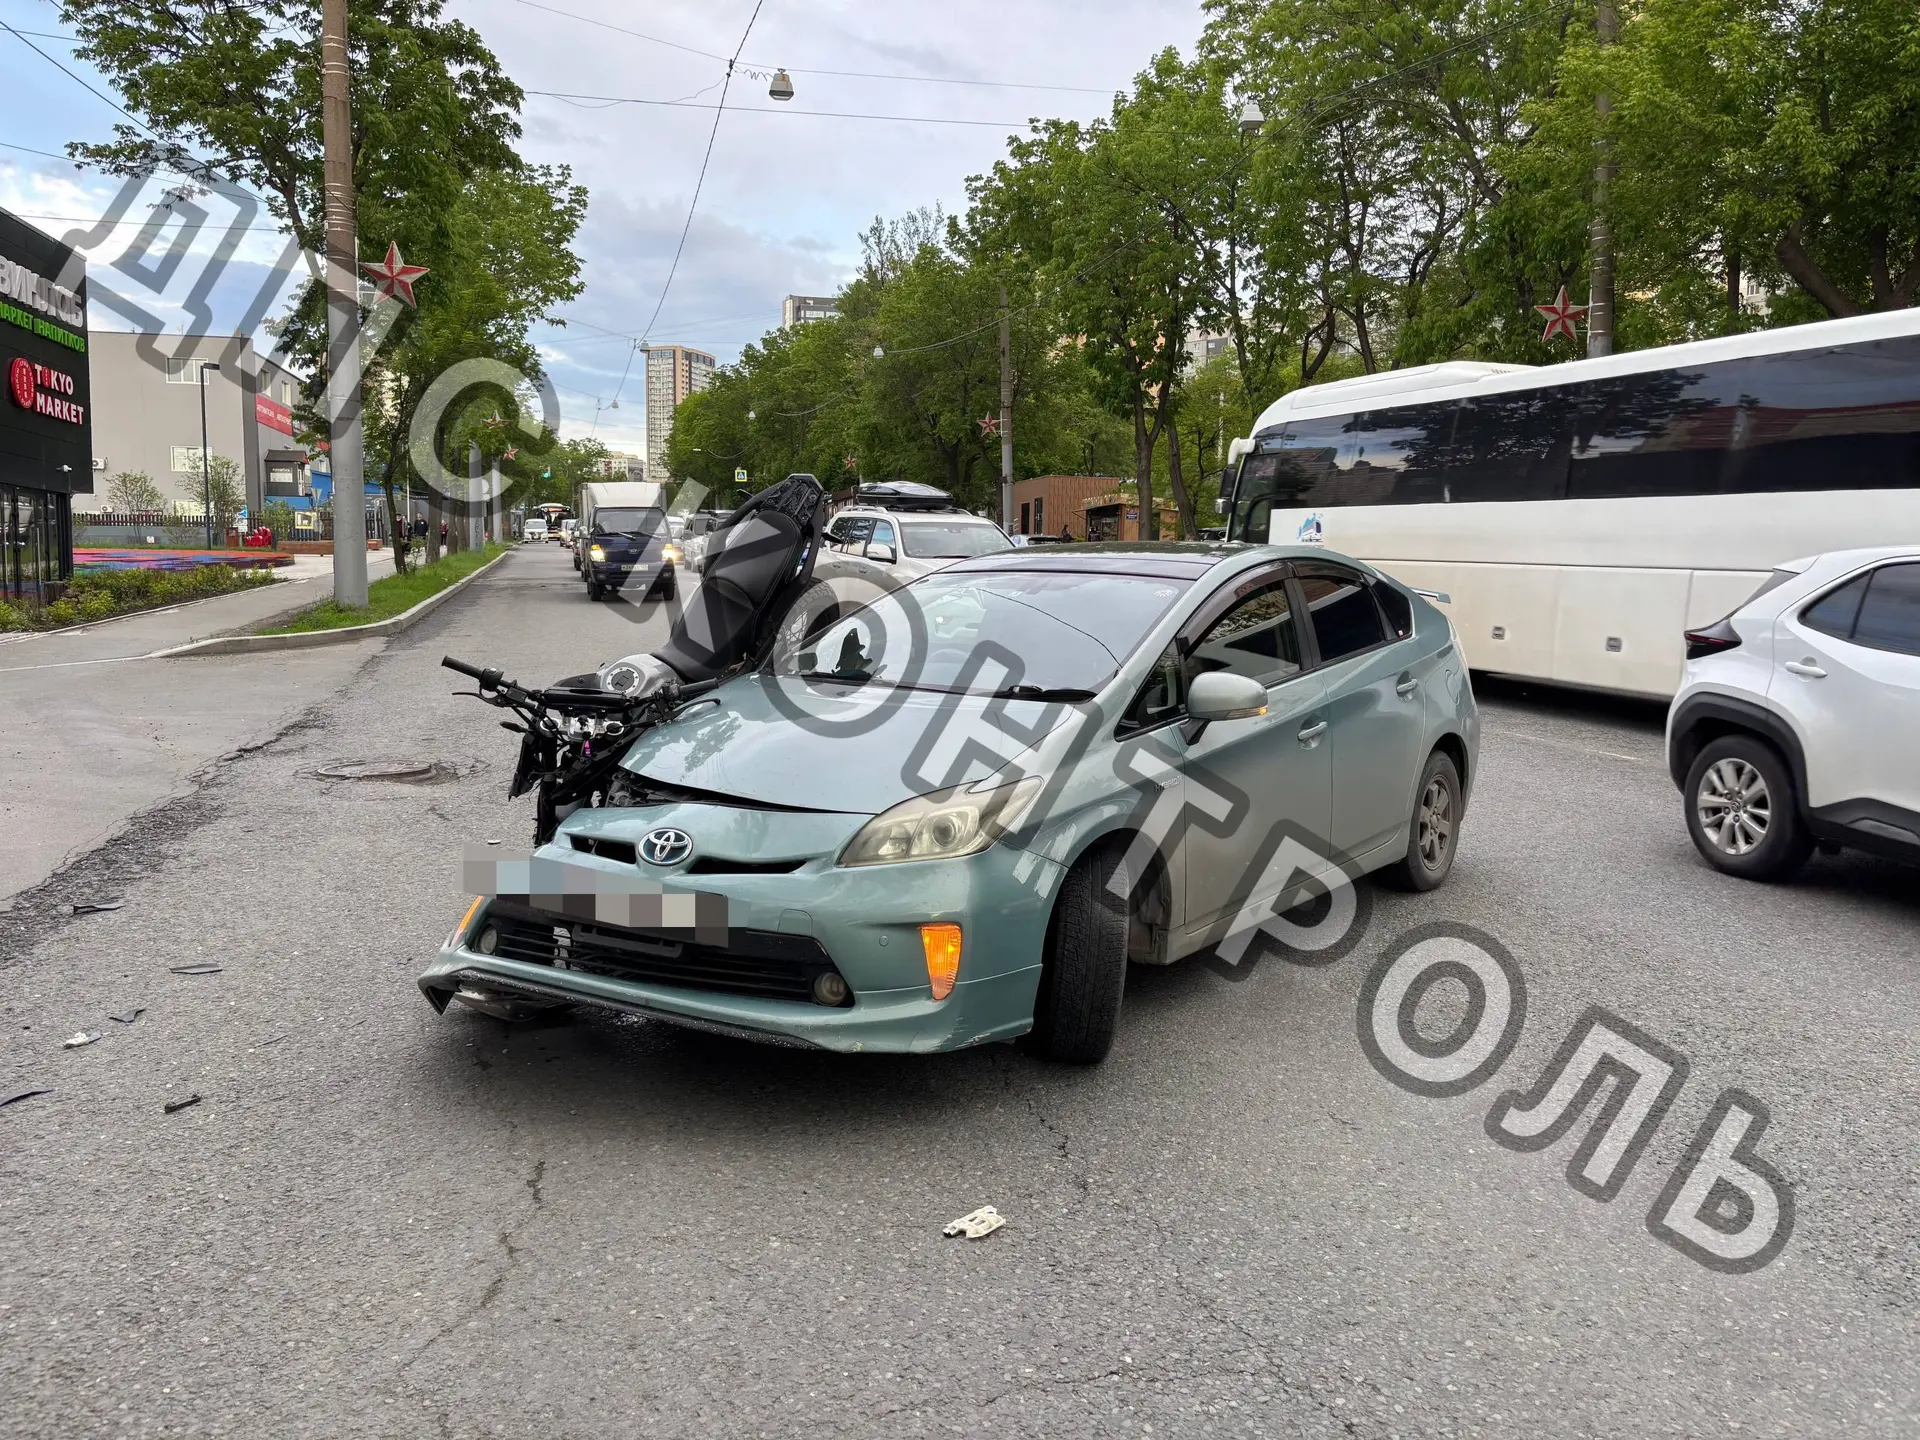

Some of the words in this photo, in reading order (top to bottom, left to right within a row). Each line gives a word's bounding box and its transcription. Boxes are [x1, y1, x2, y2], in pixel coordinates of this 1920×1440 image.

[34, 318, 85, 352] НАПИТКОВ
[35, 363, 74, 395] TOKYO
[36, 392, 84, 424] MARKET
